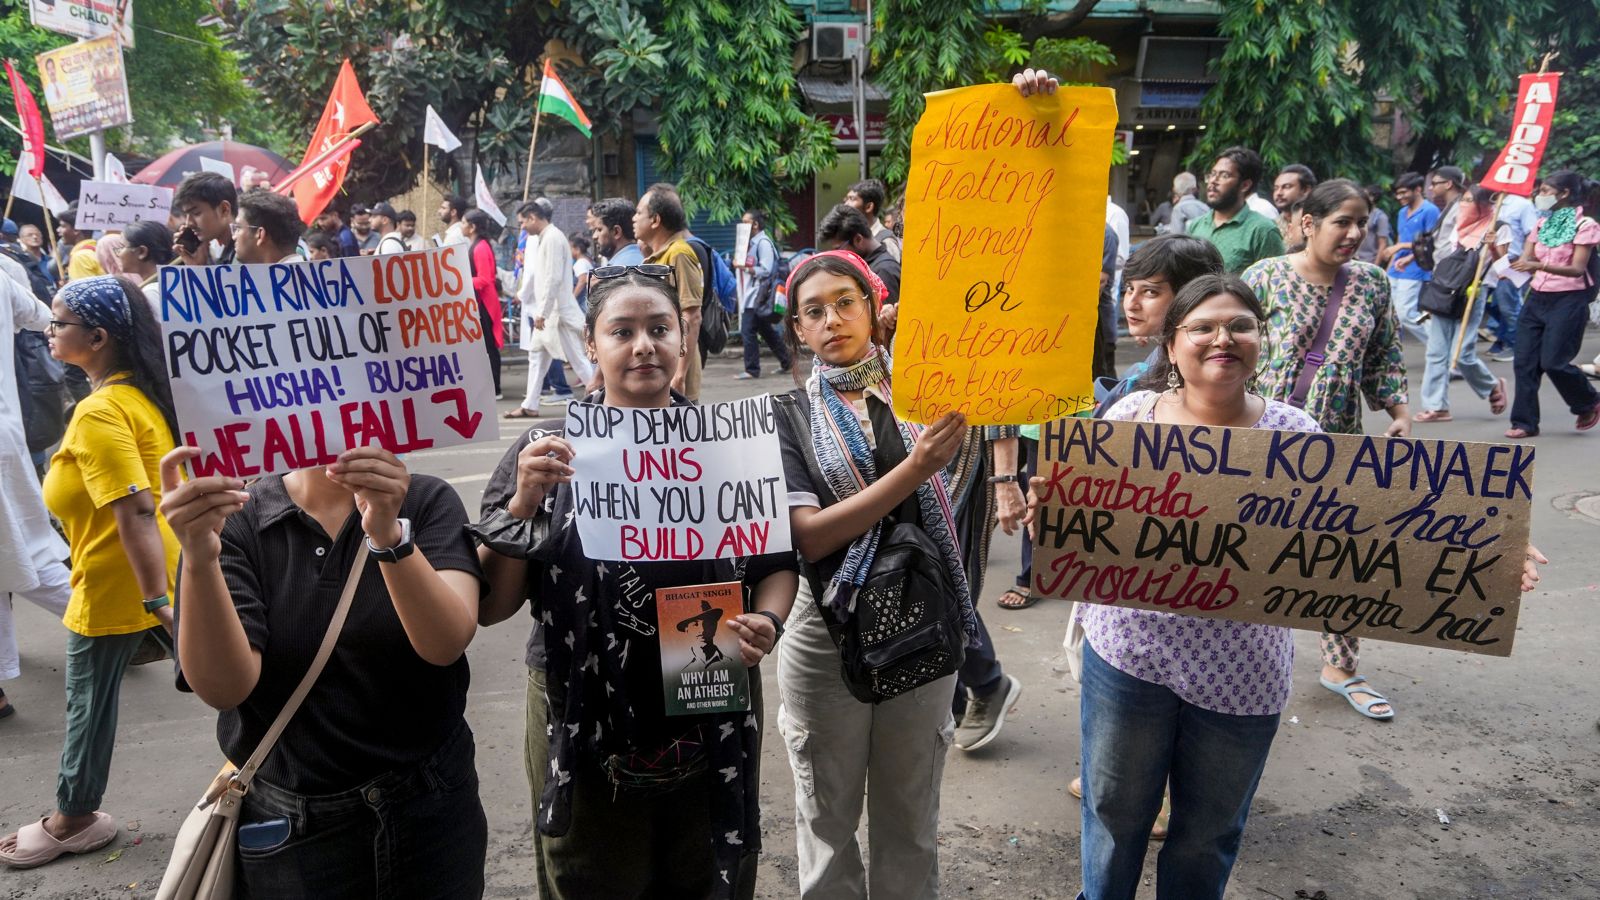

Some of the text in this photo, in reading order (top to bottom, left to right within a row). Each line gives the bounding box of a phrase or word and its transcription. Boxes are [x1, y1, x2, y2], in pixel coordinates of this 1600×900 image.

[69, 5, 109, 26] CHALO
[926, 100, 1080, 151] National
[1494, 82, 1553, 184] AIDSO
[921, 158, 1057, 229] Testing
[919, 207, 1033, 284] Agency
[161, 247, 464, 323] RINGA RINGA LOTUS
[168, 298, 483, 379] POCKET FULL OF PAPERS
[904, 314, 1070, 360] National
[225, 352, 464, 415] HUSHA! BUSHA!
[904, 360, 1026, 401] Torture
[185, 398, 434, 478] WE ALL FALL
[567, 396, 776, 445] STOP DEMOLISHING
[623, 448, 703, 482] UNIS
[1045, 418, 1536, 500] HAR NASL KO APNA EK
[574, 477, 780, 524] WHEN YOU CAN'T
[1039, 462, 1501, 549] Karbala milta hai
[620, 521, 770, 560] BUILD ANY
[1038, 506, 1503, 601] HAR DAUR APNA EK
[665, 589, 732, 601] BHAGAT SINGH
[1263, 585, 1404, 635] mangta
[1408, 595, 1506, 646] hai
[677, 683, 735, 700] AN ATHEIST
[680, 669, 729, 685] WHY I AM
[697, 700, 712, 709] OTHER
